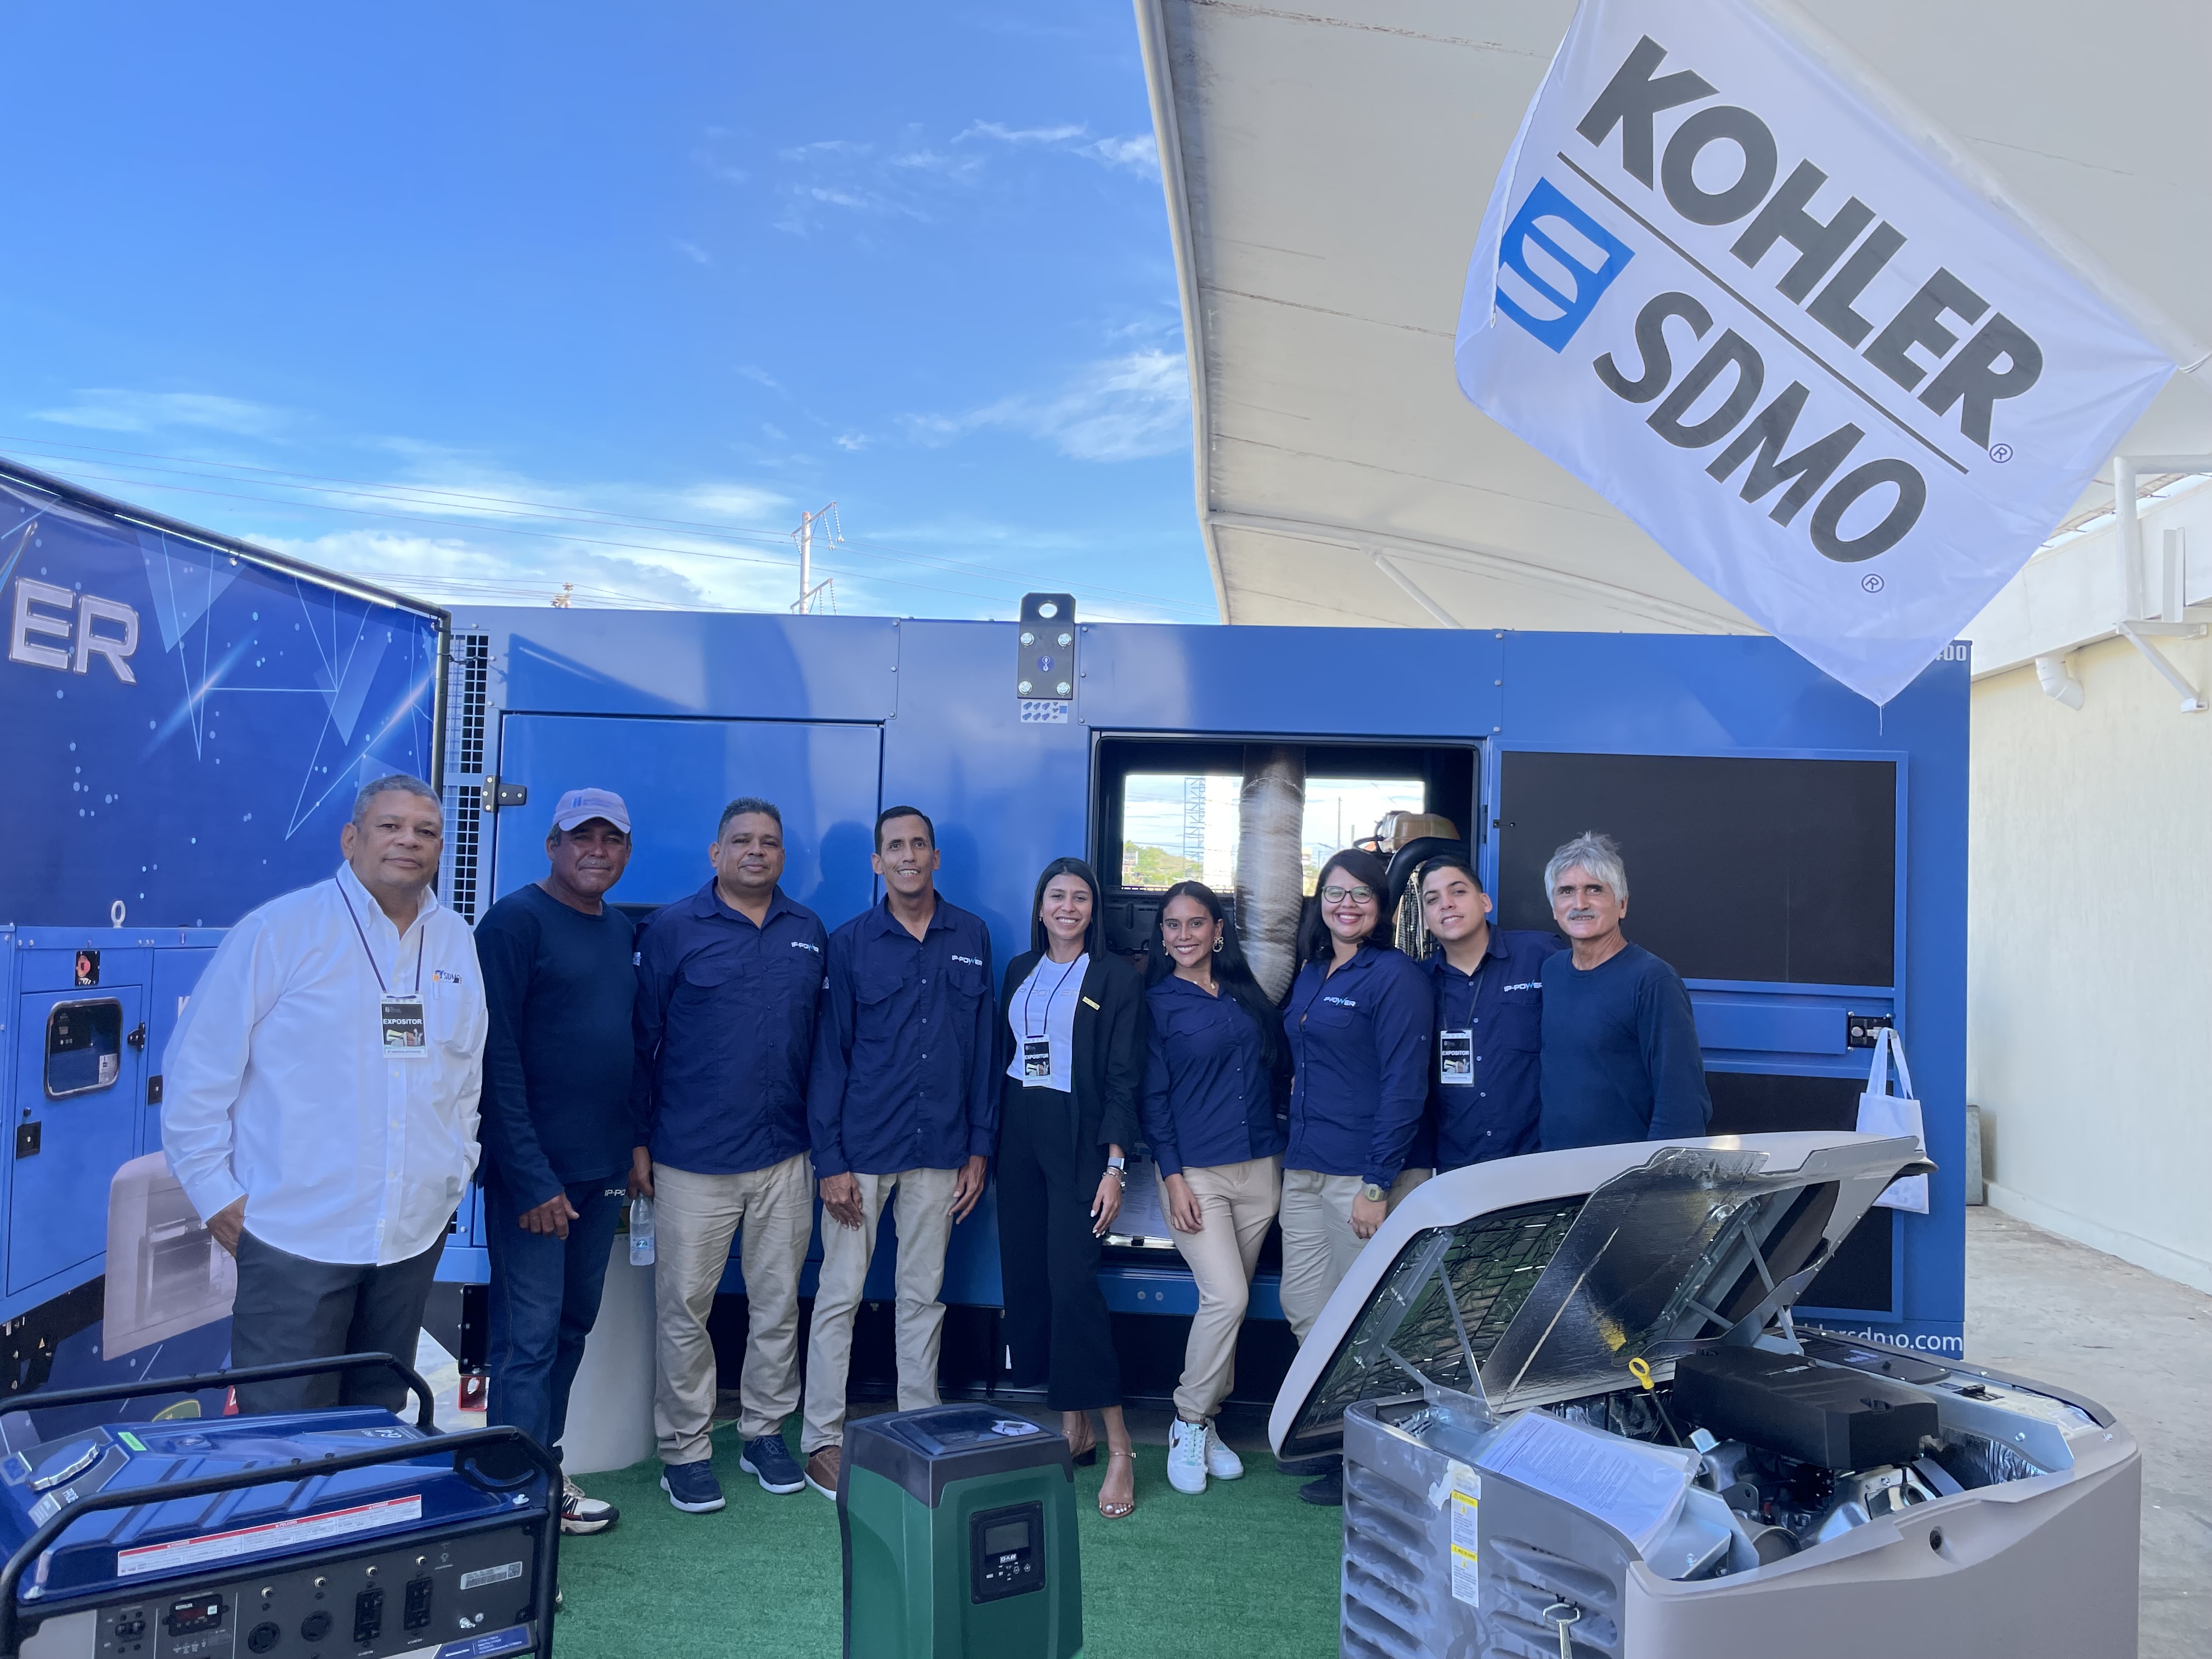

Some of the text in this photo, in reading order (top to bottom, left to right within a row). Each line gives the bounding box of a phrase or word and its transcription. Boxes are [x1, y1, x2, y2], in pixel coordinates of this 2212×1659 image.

[1576, 34, 2044, 452] KOHLER
[1593, 291, 1927, 563] SDMO
[0, 521, 139, 685] ER
[1000, 1554, 1016, 1562] DAB
